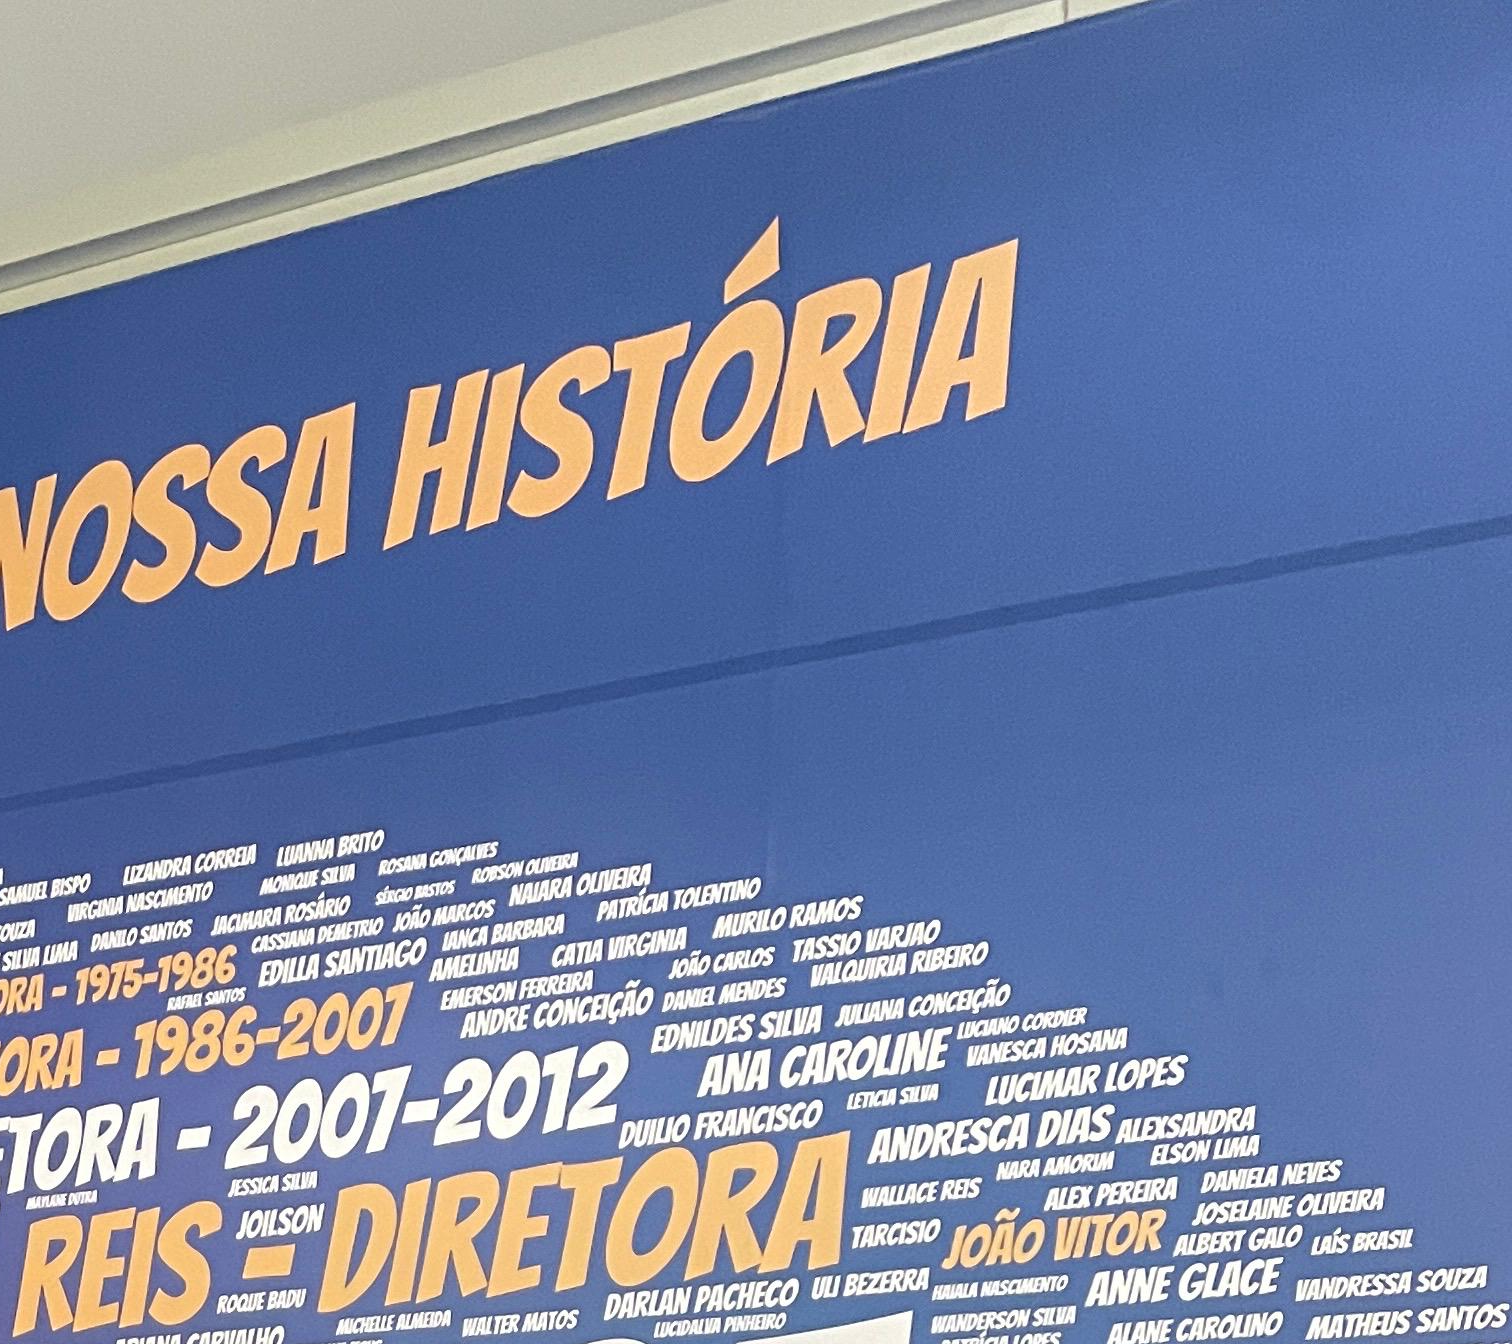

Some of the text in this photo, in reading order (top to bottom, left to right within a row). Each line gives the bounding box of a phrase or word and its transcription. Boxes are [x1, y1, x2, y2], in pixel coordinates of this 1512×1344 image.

[382, 216, 1019, 551] HISTÓRIA
[122, 844, 256, 886] LIZANDRA CORREIA
[276, 829, 384, 867] LUANNA BRITO
[508, 863, 652, 907] NAIARA OLIVEIRA
[596, 877, 761, 922] PATRÍCIA TOLENTINO
[712, 896, 863, 939] MURILO RAMOS
[75, 944, 238, 1006] 1975-1986
[258, 937, 427, 989] EDILLA SANTIAGO
[134, 981, 414, 1079] 1986-2007
[697, 1026, 953, 1097] ANA CAROLINE
[984, 1055, 1188, 1106] LUCIMAR LOPES
[222, 1040, 629, 1172] 2007-2012
[867, 1104, 1115, 1164] ANDRESCA DIAS
[11, 1199, 224, 1340] REIS
[316, 1128, 851, 1316] DIRETORA
[234, 1203, 325, 1241] JOILSON
[942, 1207, 1167, 1271] JOÃO VITOR
[1085, 1257, 1283, 1307] ANNE GLACE
[1305, 1303, 1510, 1340] MATHEUS SANTOS
